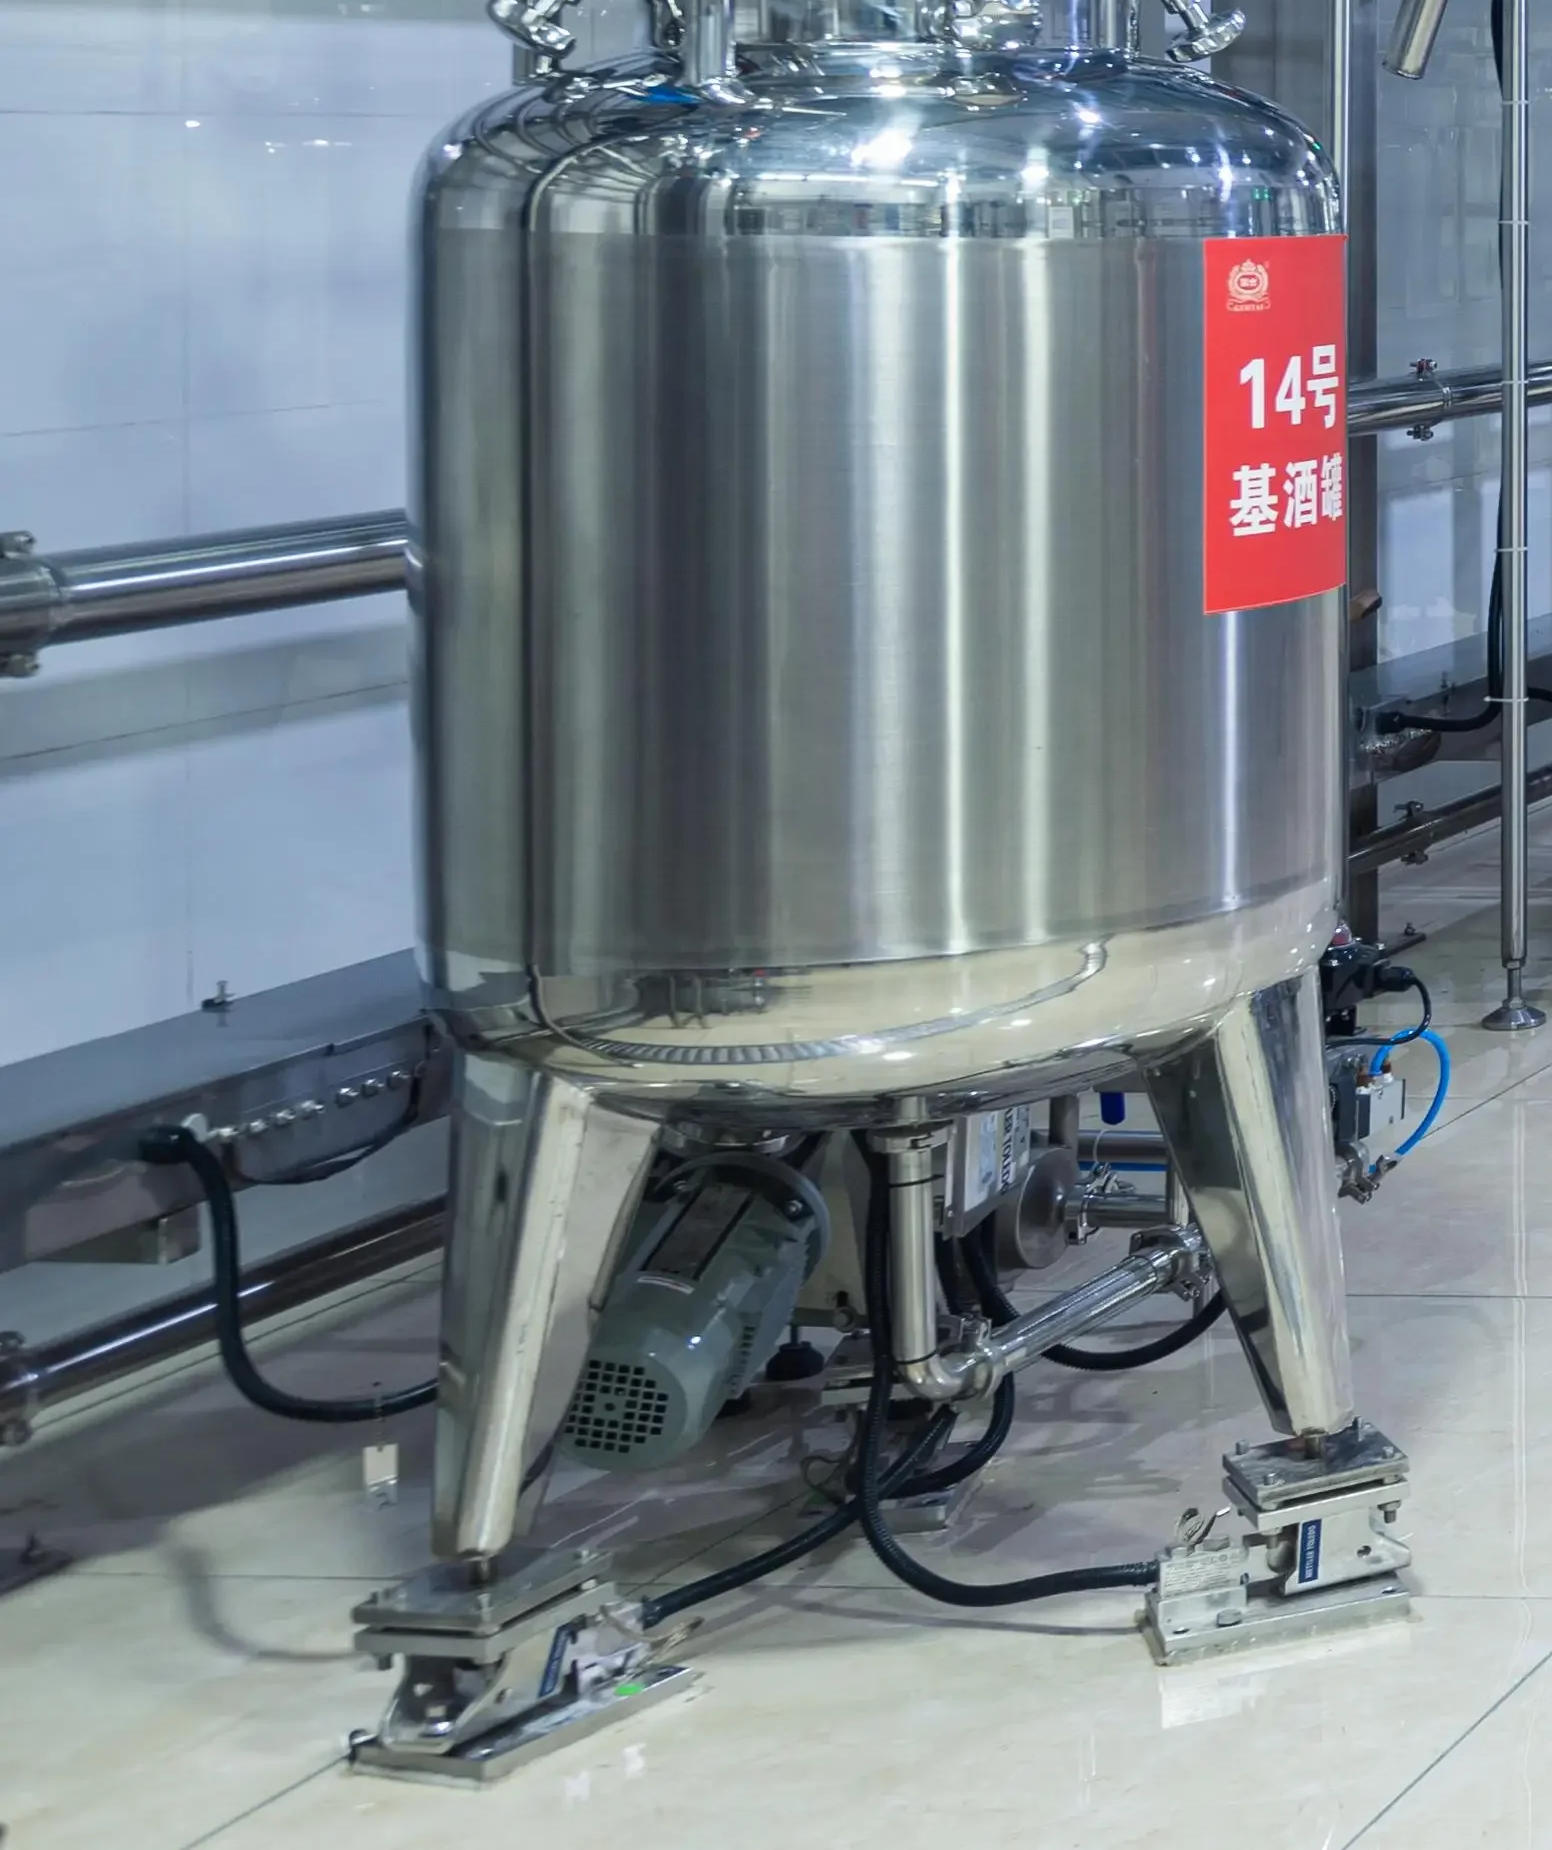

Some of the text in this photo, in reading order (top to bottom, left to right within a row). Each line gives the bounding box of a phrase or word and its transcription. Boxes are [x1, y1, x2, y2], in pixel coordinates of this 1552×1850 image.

[1239, 344, 1339, 429] 14号
[1229, 452, 1343, 537] 基酒罐
